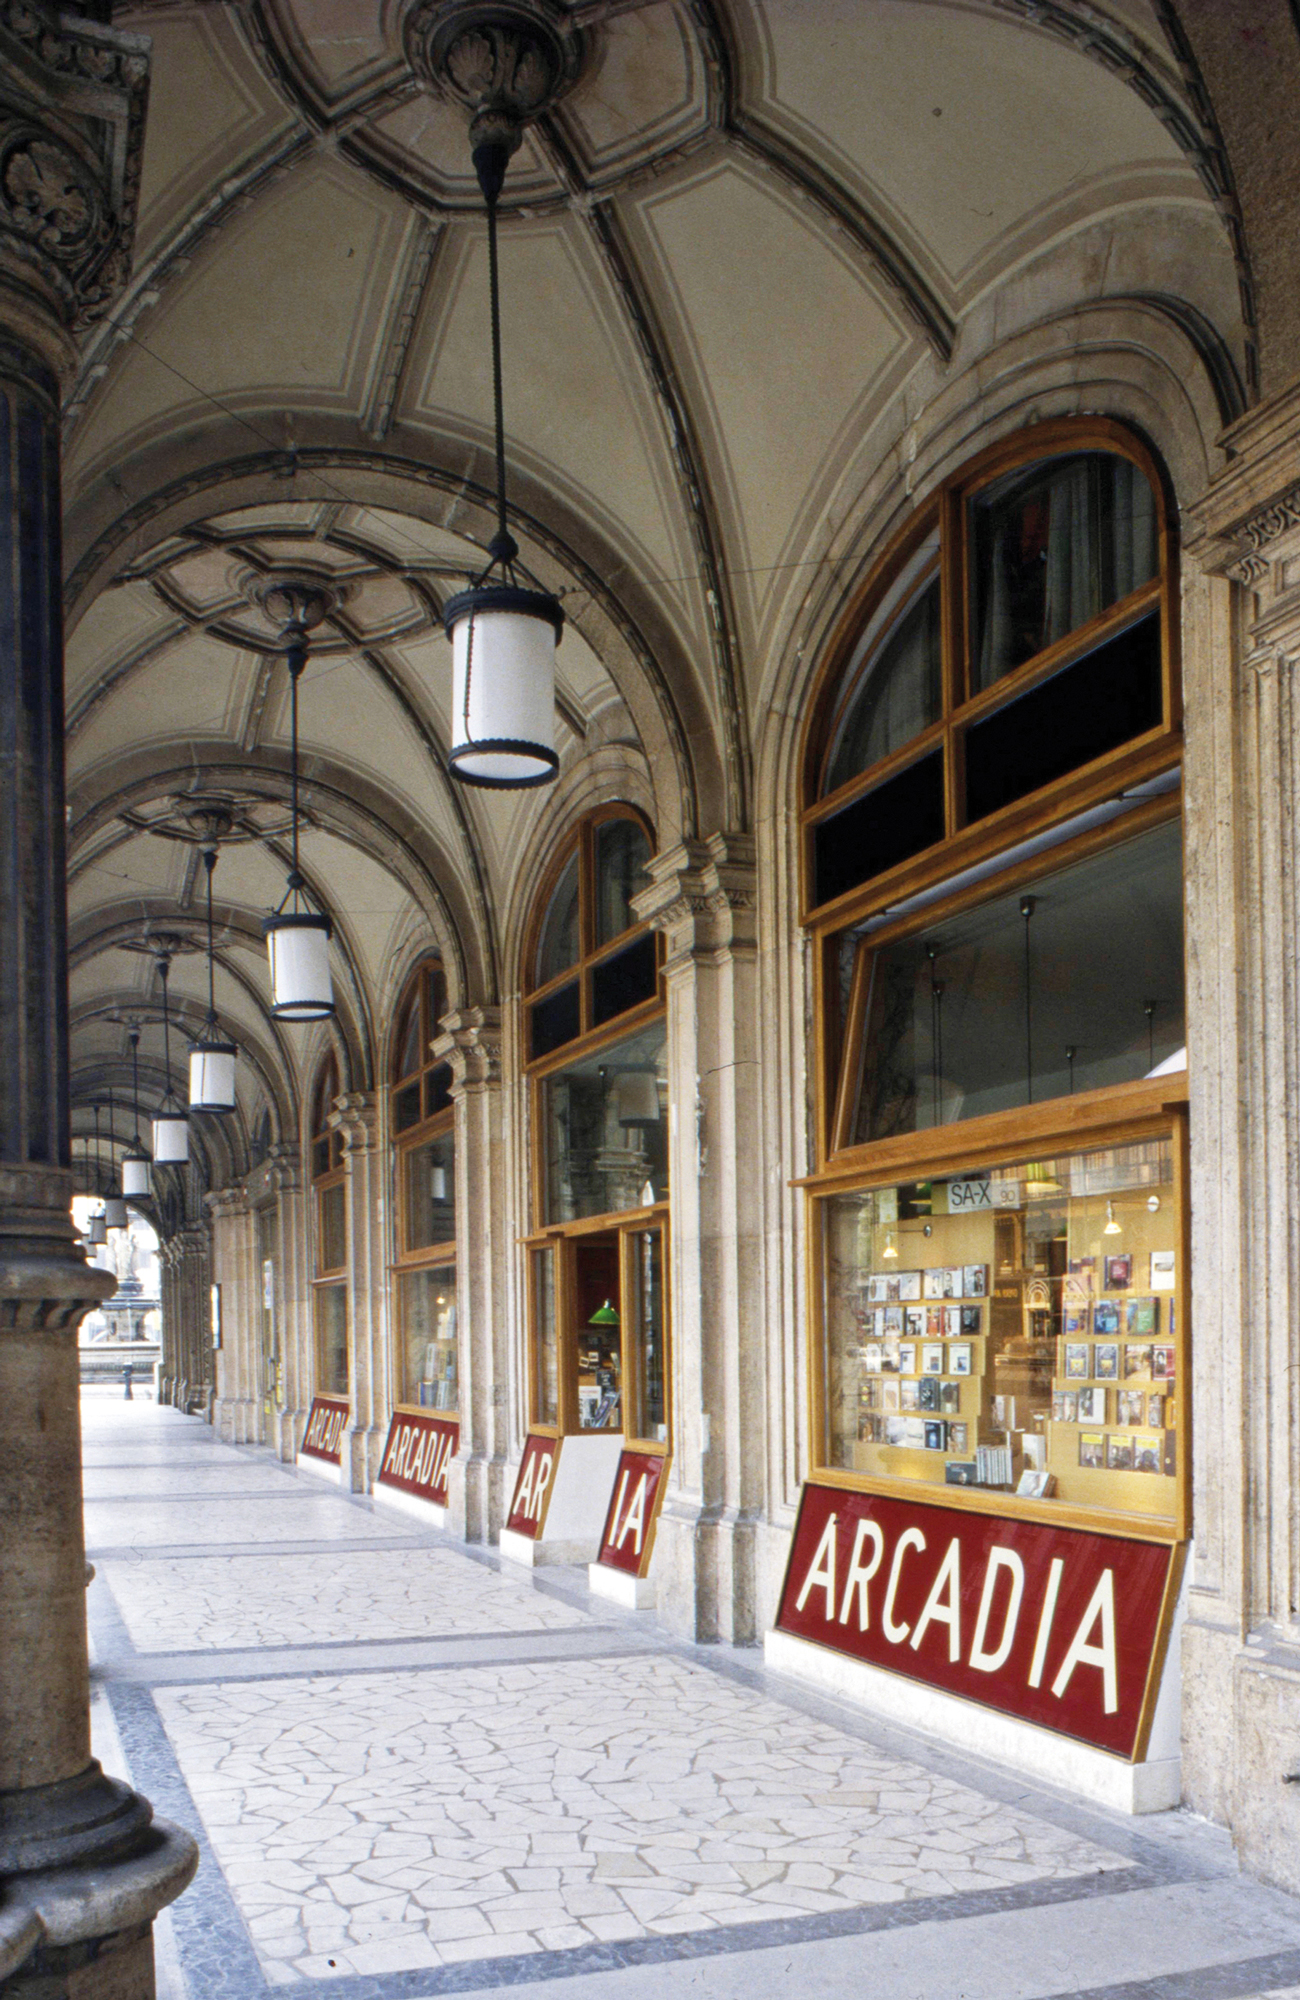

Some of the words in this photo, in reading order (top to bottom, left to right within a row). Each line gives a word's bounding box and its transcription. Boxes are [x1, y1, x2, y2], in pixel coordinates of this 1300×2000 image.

[951, 1181, 992, 1206] SA-X
[305, 1407, 347, 1455] ARCADI
[384, 1424, 454, 1492] ARCADIA
[512, 1451, 553, 1522] AR
[608, 1470, 647, 1555] IA
[795, 1512, 1119, 1715] ARCADIA
